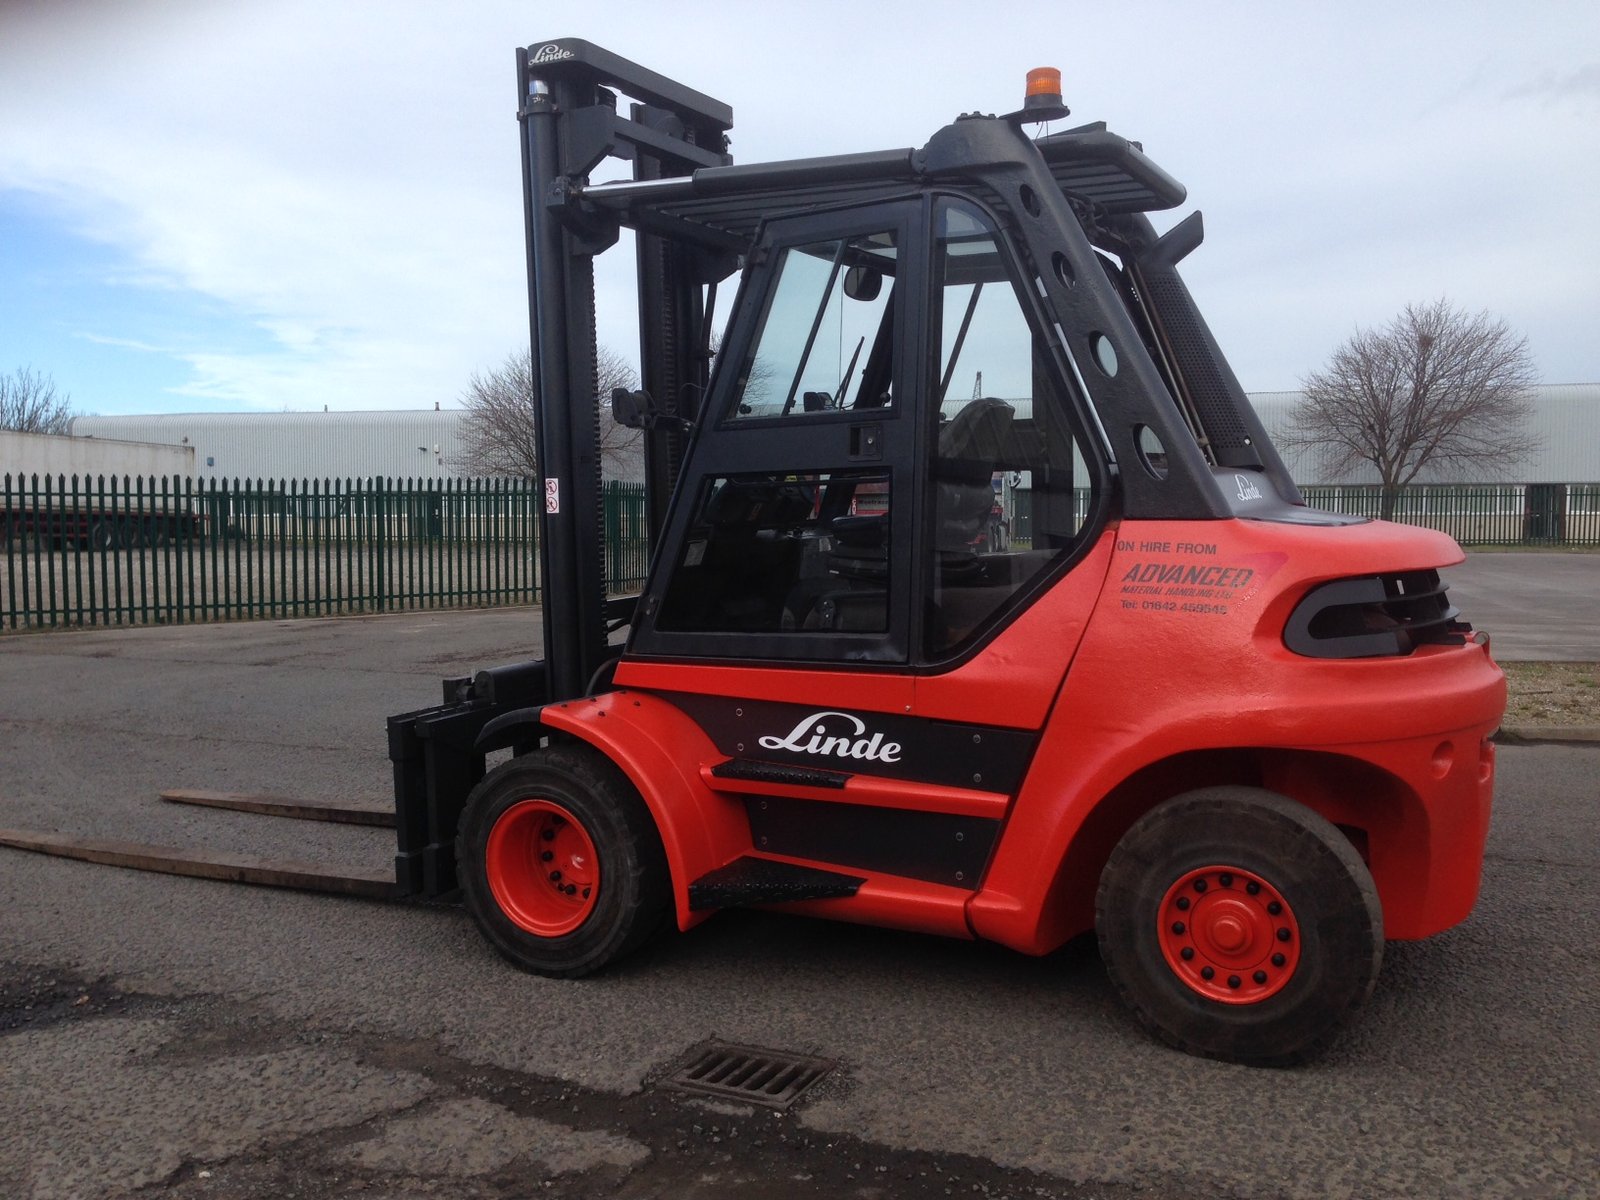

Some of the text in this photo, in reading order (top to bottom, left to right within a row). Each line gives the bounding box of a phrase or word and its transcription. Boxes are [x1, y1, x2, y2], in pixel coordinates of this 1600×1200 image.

[528, 44, 574, 65] Linde
[1235, 474, 1262, 500] Linde
[1117, 541, 1217, 555] ON HIRE FROM
[1121, 563, 1254, 588] ADVANCED
[1120, 585, 1162, 595] MATERIAL
[758, 711, 902, 763] Linde
